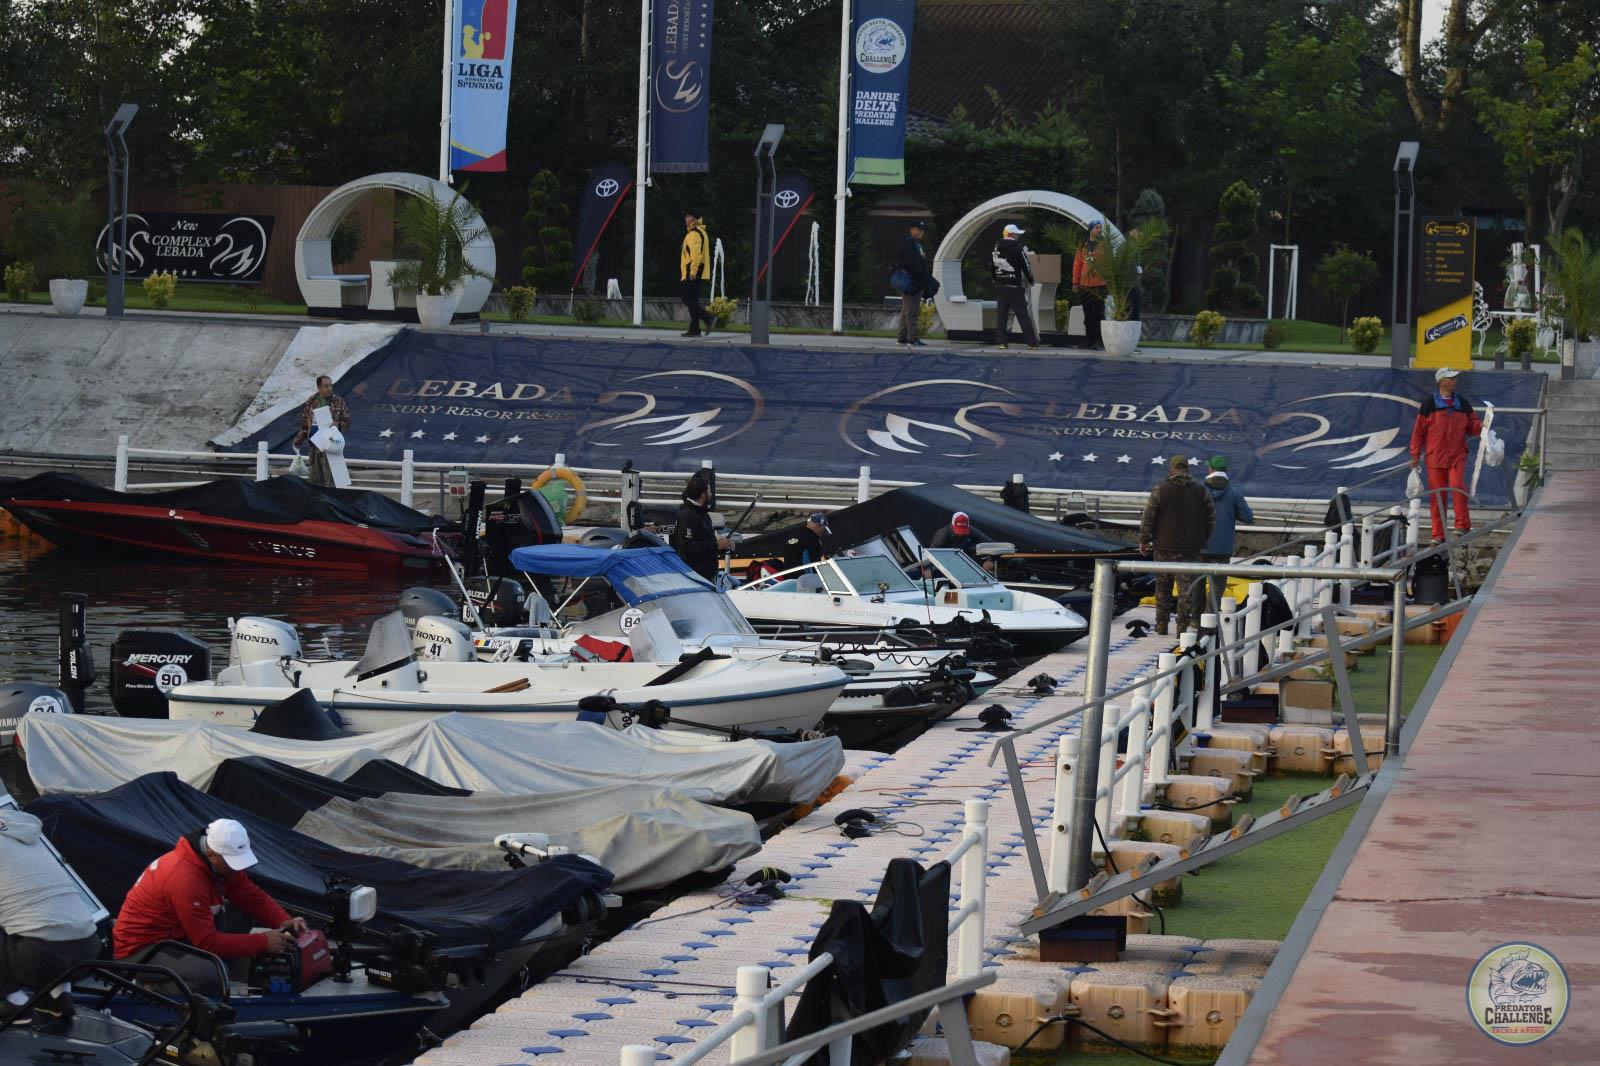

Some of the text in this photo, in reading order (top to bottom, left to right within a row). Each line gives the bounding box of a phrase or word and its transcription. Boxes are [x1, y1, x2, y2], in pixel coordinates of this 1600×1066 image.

[860, 52, 897, 64] CHALLENGE
[457, 62, 504, 78] LIGA
[457, 80, 503, 90] SPINNING
[856, 91, 900, 101] DANUBE
[855, 100, 897, 112] DELTA
[171, 220, 199, 231] New
[152, 235, 212, 247] COMPLEX
[156, 246, 204, 257] LEBADA
[384, 378, 573, 401] LEBADA
[1043, 400, 1243, 424] LEBADA
[624, 617, 641, 628] 84
[236, 632, 279, 646] HONDA
[415, 630, 453, 645] HONDA
[429, 643, 442, 657] 41
[69, 650, 78, 679] TALON
[123, 653, 193, 666] MERCURY
[161, 673, 182, 687] 90
